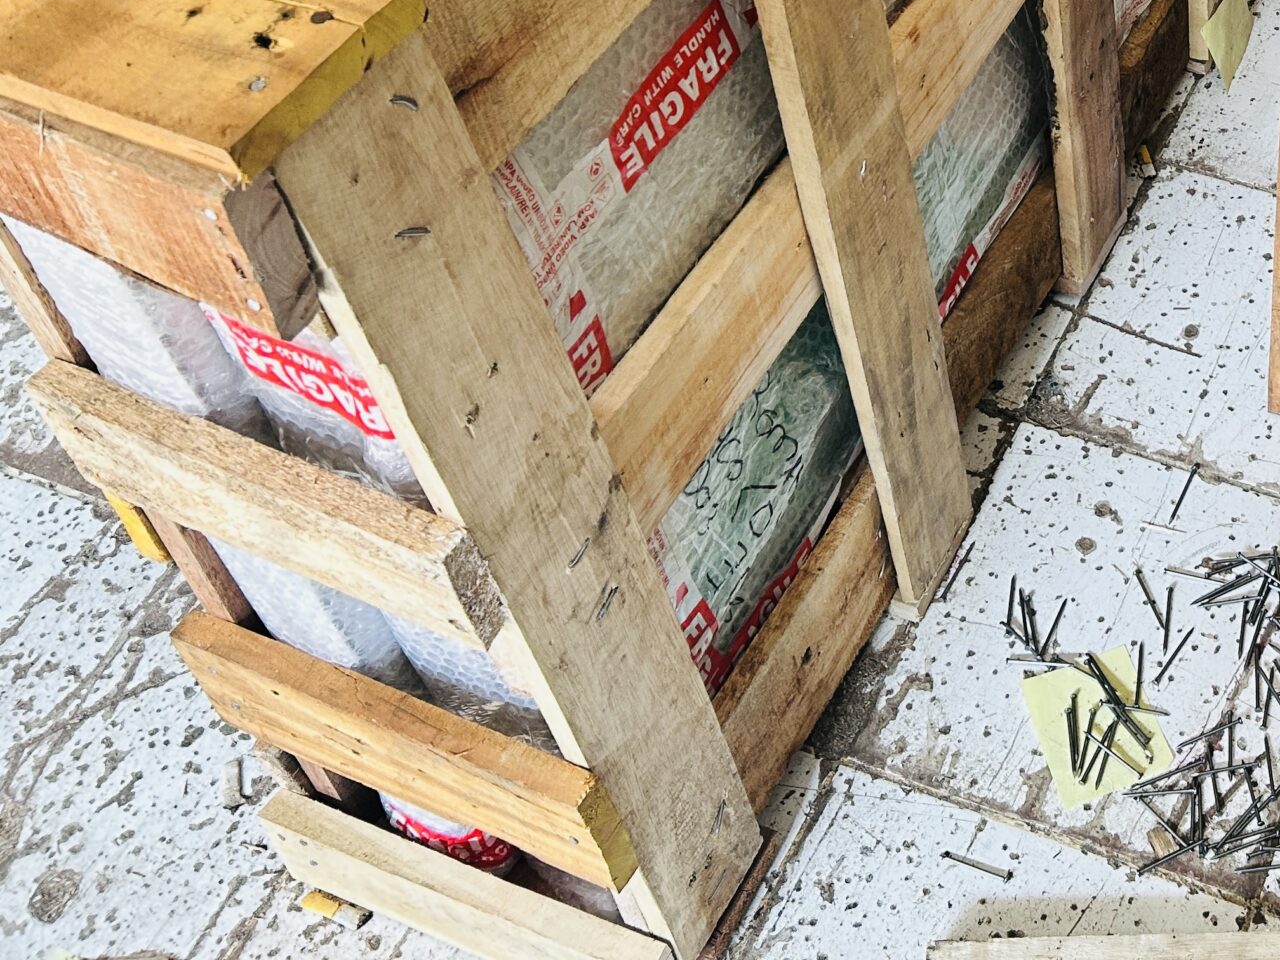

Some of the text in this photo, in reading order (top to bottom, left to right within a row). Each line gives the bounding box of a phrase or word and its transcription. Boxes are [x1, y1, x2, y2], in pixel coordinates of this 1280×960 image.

[673, 8, 720, 69] HANDLE
[619, 28, 734, 179] FRAGILE
[643, 66, 675, 106] WITH
